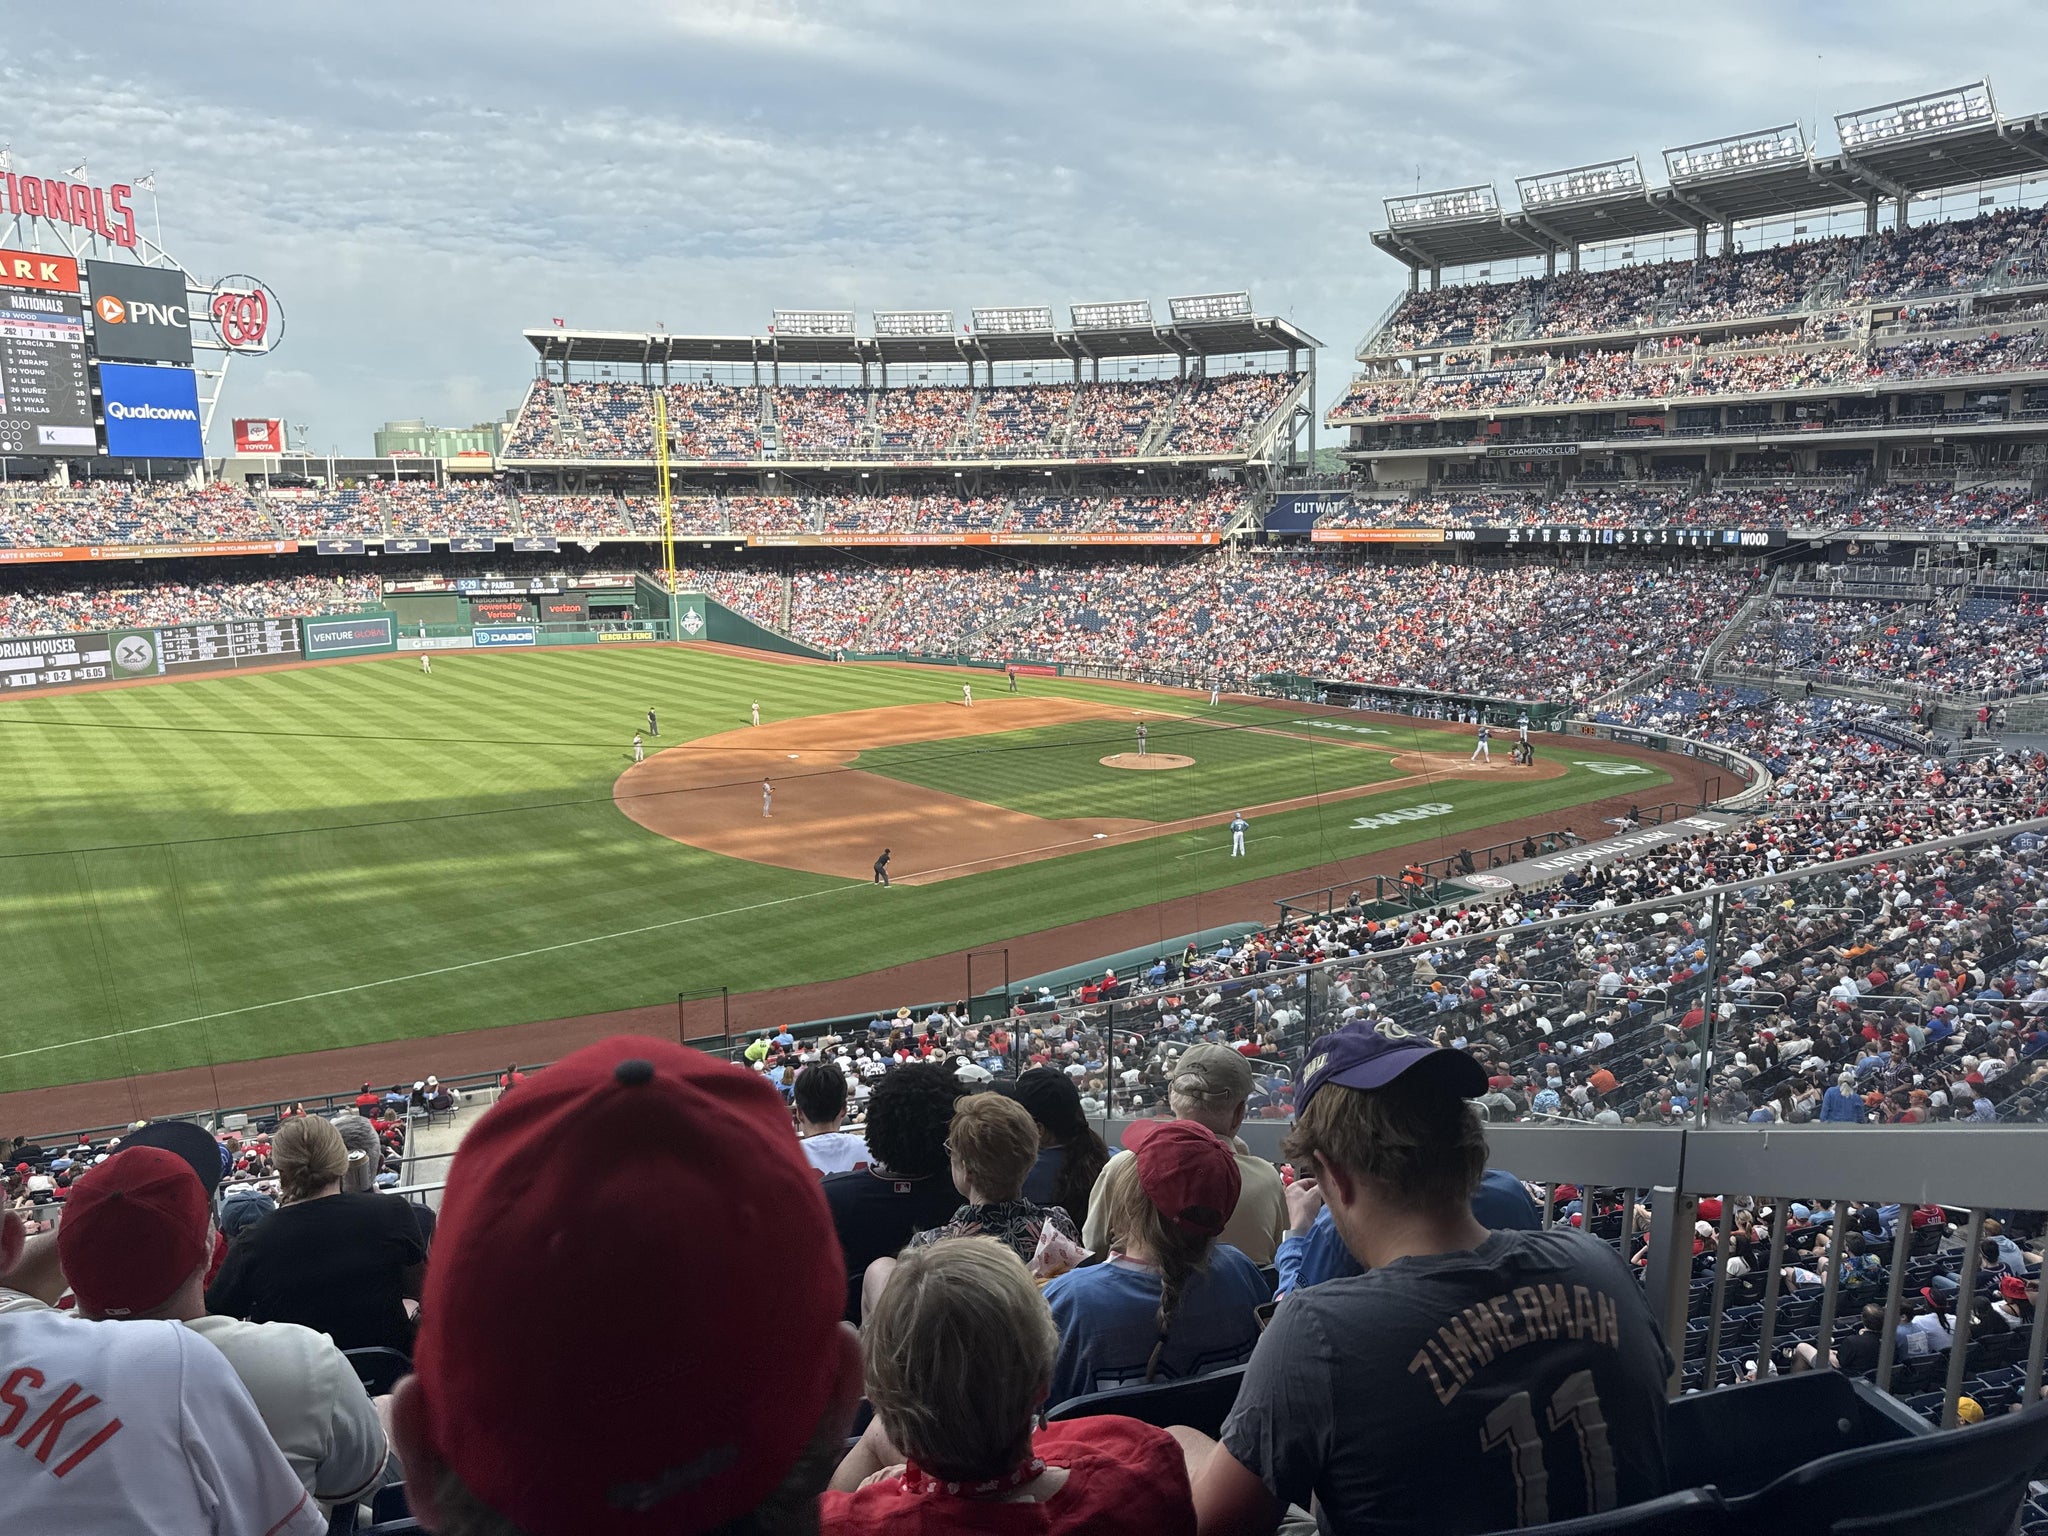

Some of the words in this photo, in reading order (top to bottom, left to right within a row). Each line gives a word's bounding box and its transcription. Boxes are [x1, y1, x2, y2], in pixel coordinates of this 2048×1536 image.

[11, 295, 64, 313] NATIONALS
[12, 312, 37, 320] WOOD
[126, 301, 188, 328] PNC
[19, 368, 46, 376] YOUNG
[107, 401, 197, 421] Qualcomm
[46, 431, 56, 441] K
[244, 443, 274, 451] TOYOTA
[1507, 447, 1553, 456] CHAMPIONS
[1554, 446, 1576, 454] CLUB
[1445, 531, 1454, 540] 29
[1455, 531, 1476, 541] WOOD
[1631, 531, 1638, 542] 3
[1661, 531, 1668, 543] 5
[1678, 536, 1683, 545] 0
[1692, 536, 1697, 545] 0
[1706, 536, 1711, 545] 1
[1740, 532, 1769, 546] WOOD
[25, 551, 64, 559] RECYCLING
[460, 580, 477, 590] 5:29
[491, 581, 515, 589] PARKER
[472, 595, 509, 603] Nationals
[509, 595, 528, 603] Park
[478, 603, 512, 611] powered
[512, 602, 523, 611] by
[549, 604, 581, 613] verizon
[486, 611, 517, 619] Verizon
[313, 631, 353, 643] VENTURE
[354, 629, 386, 639] GLOBAL
[490, 632, 533, 642] DABOS
[599, 633, 632, 641] HERCULES
[632, 632, 653, 640] FENCE
[33, 638, 76, 656] HOUSER
[20, 675, 28, 685] 11
[53, 671, 67, 682] 0-2
[86, 668, 103, 678] 6.05
[2020, 838, 2033, 847] 26
[1532, 841, 1635, 871] NATIONALS
[1631, 829, 1677, 846] PARK
[1407, 1283, 1620, 1407] ZIMMERMAN
[1479, 1369, 1619, 1529] 11
